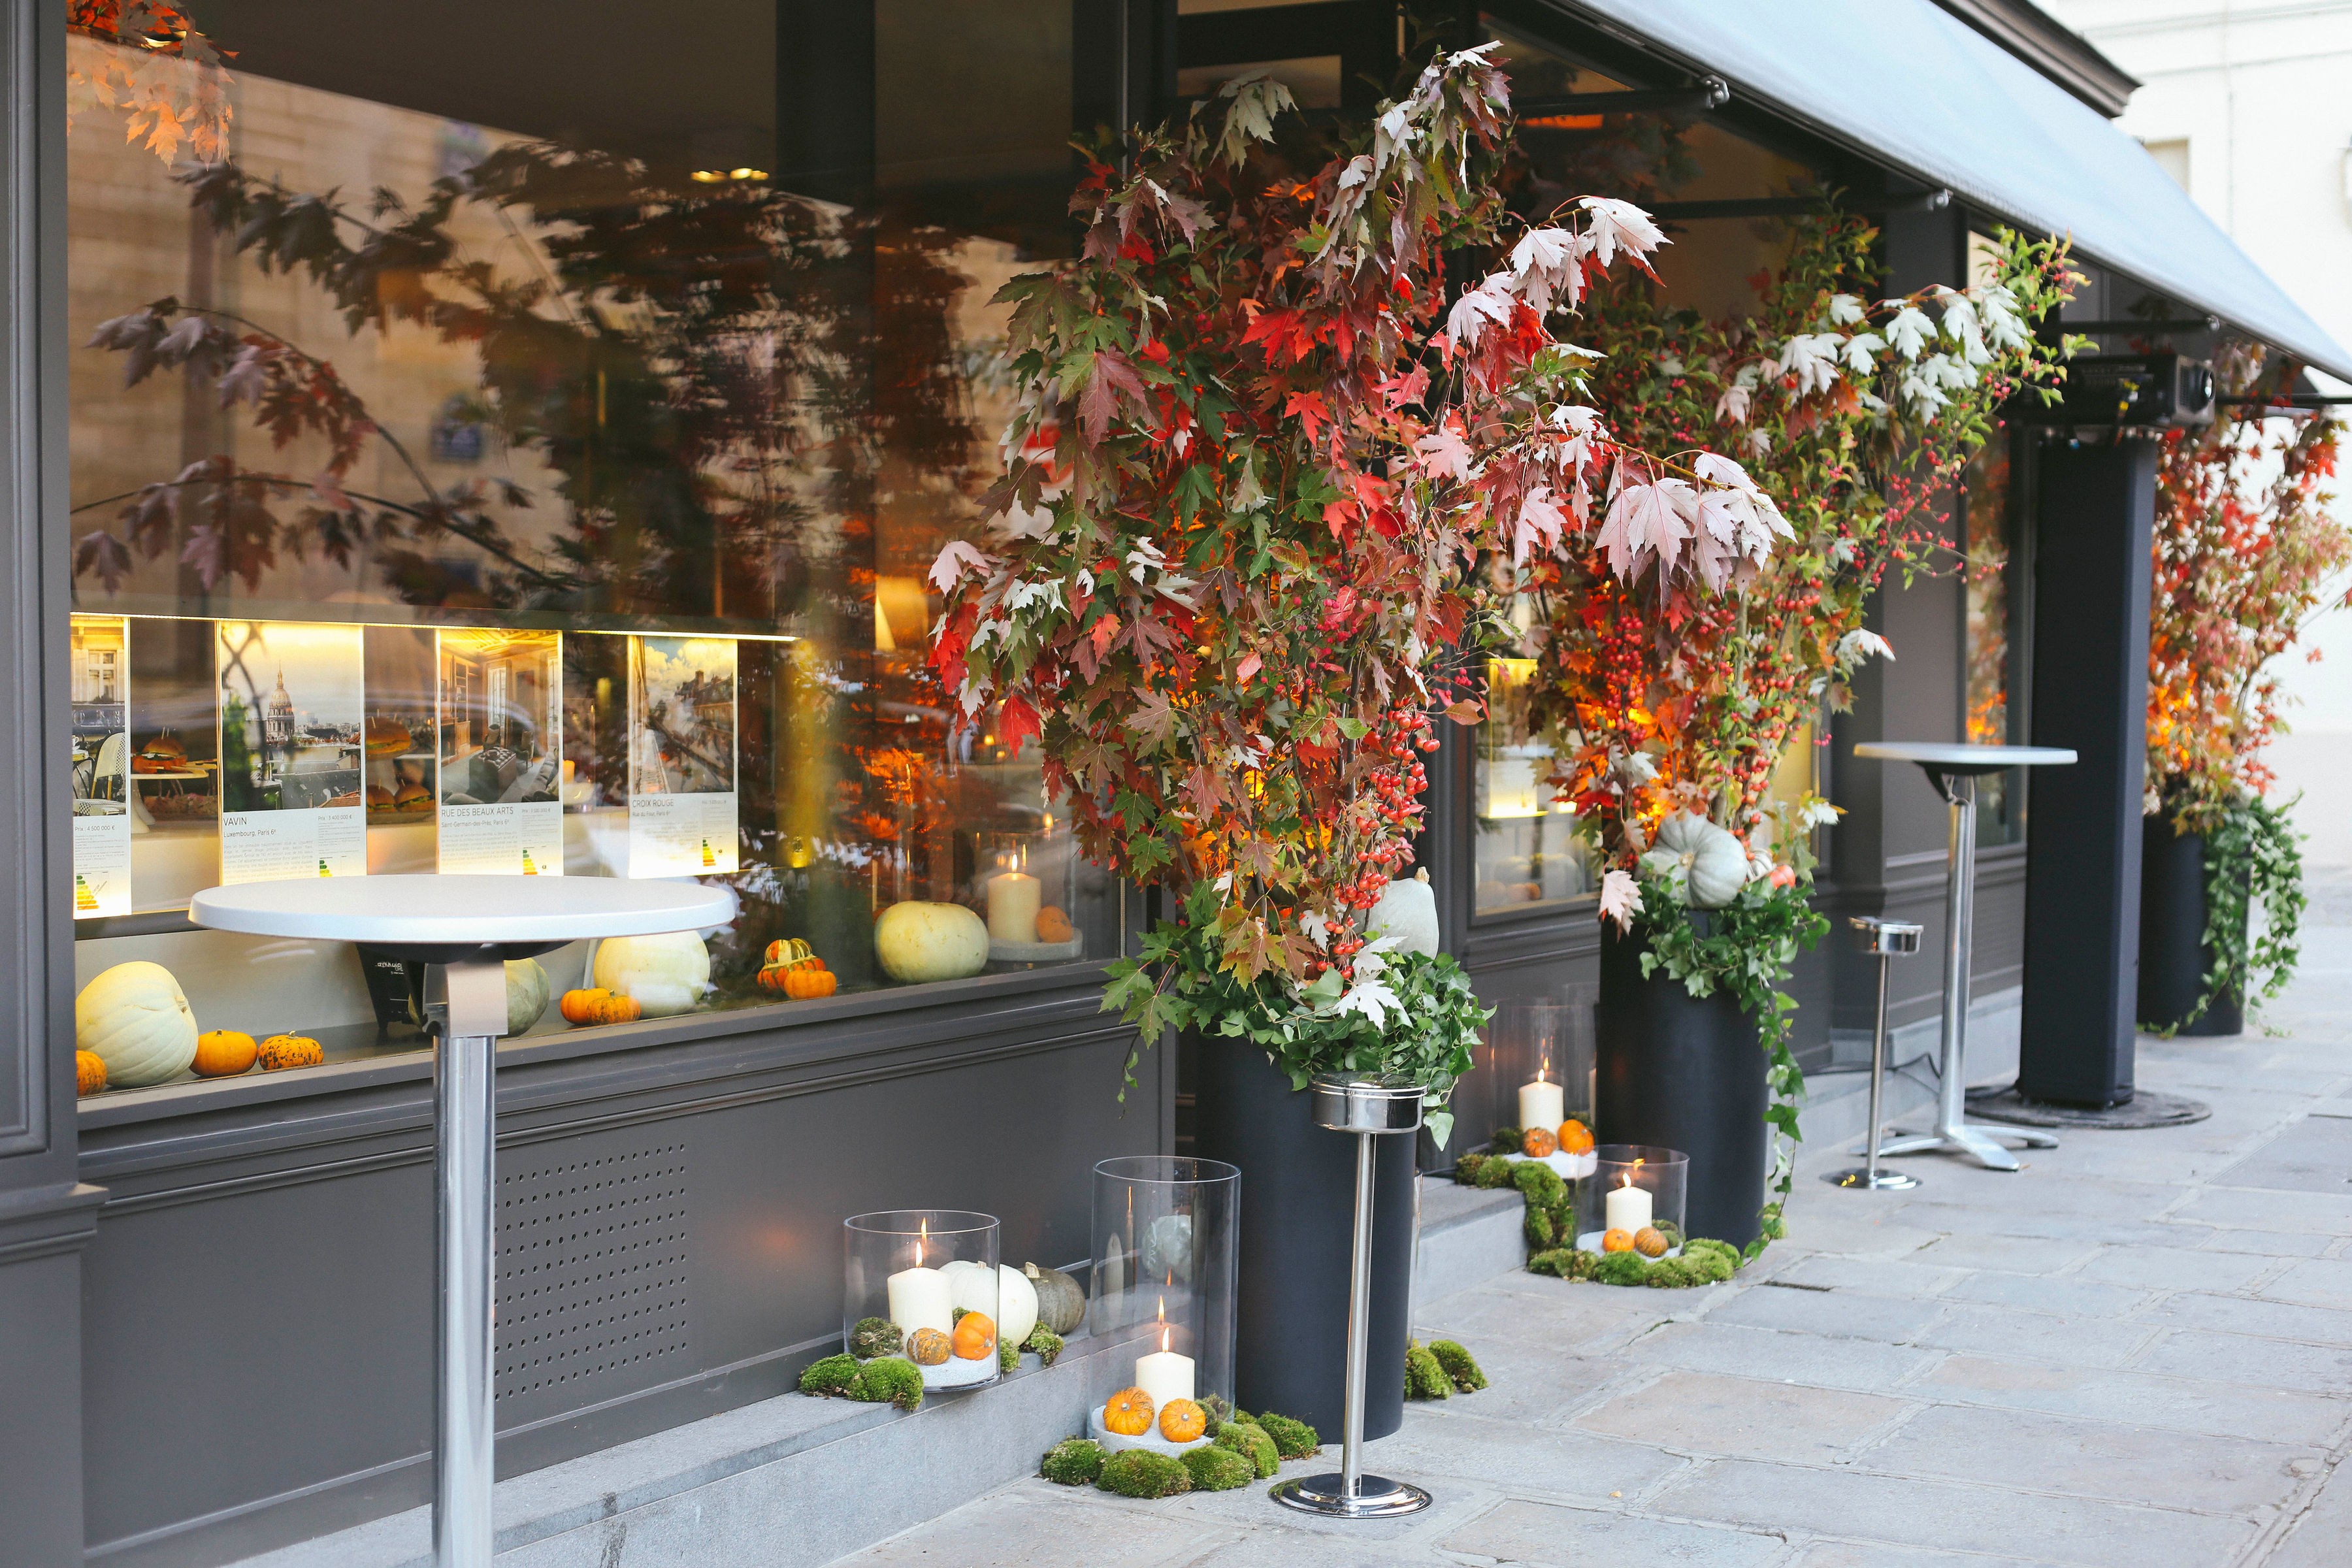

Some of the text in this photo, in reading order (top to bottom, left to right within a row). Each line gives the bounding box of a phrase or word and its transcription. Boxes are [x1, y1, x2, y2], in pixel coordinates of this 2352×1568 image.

[632, 799, 674, 808] CROIX ROUGE
[441, 809, 455, 817] RUE
[457, 808, 470, 817] DES
[472, 808, 495, 816] BEAUX
[496, 806, 514, 815] ARTS
[223, 816, 247, 826] VAVIN
